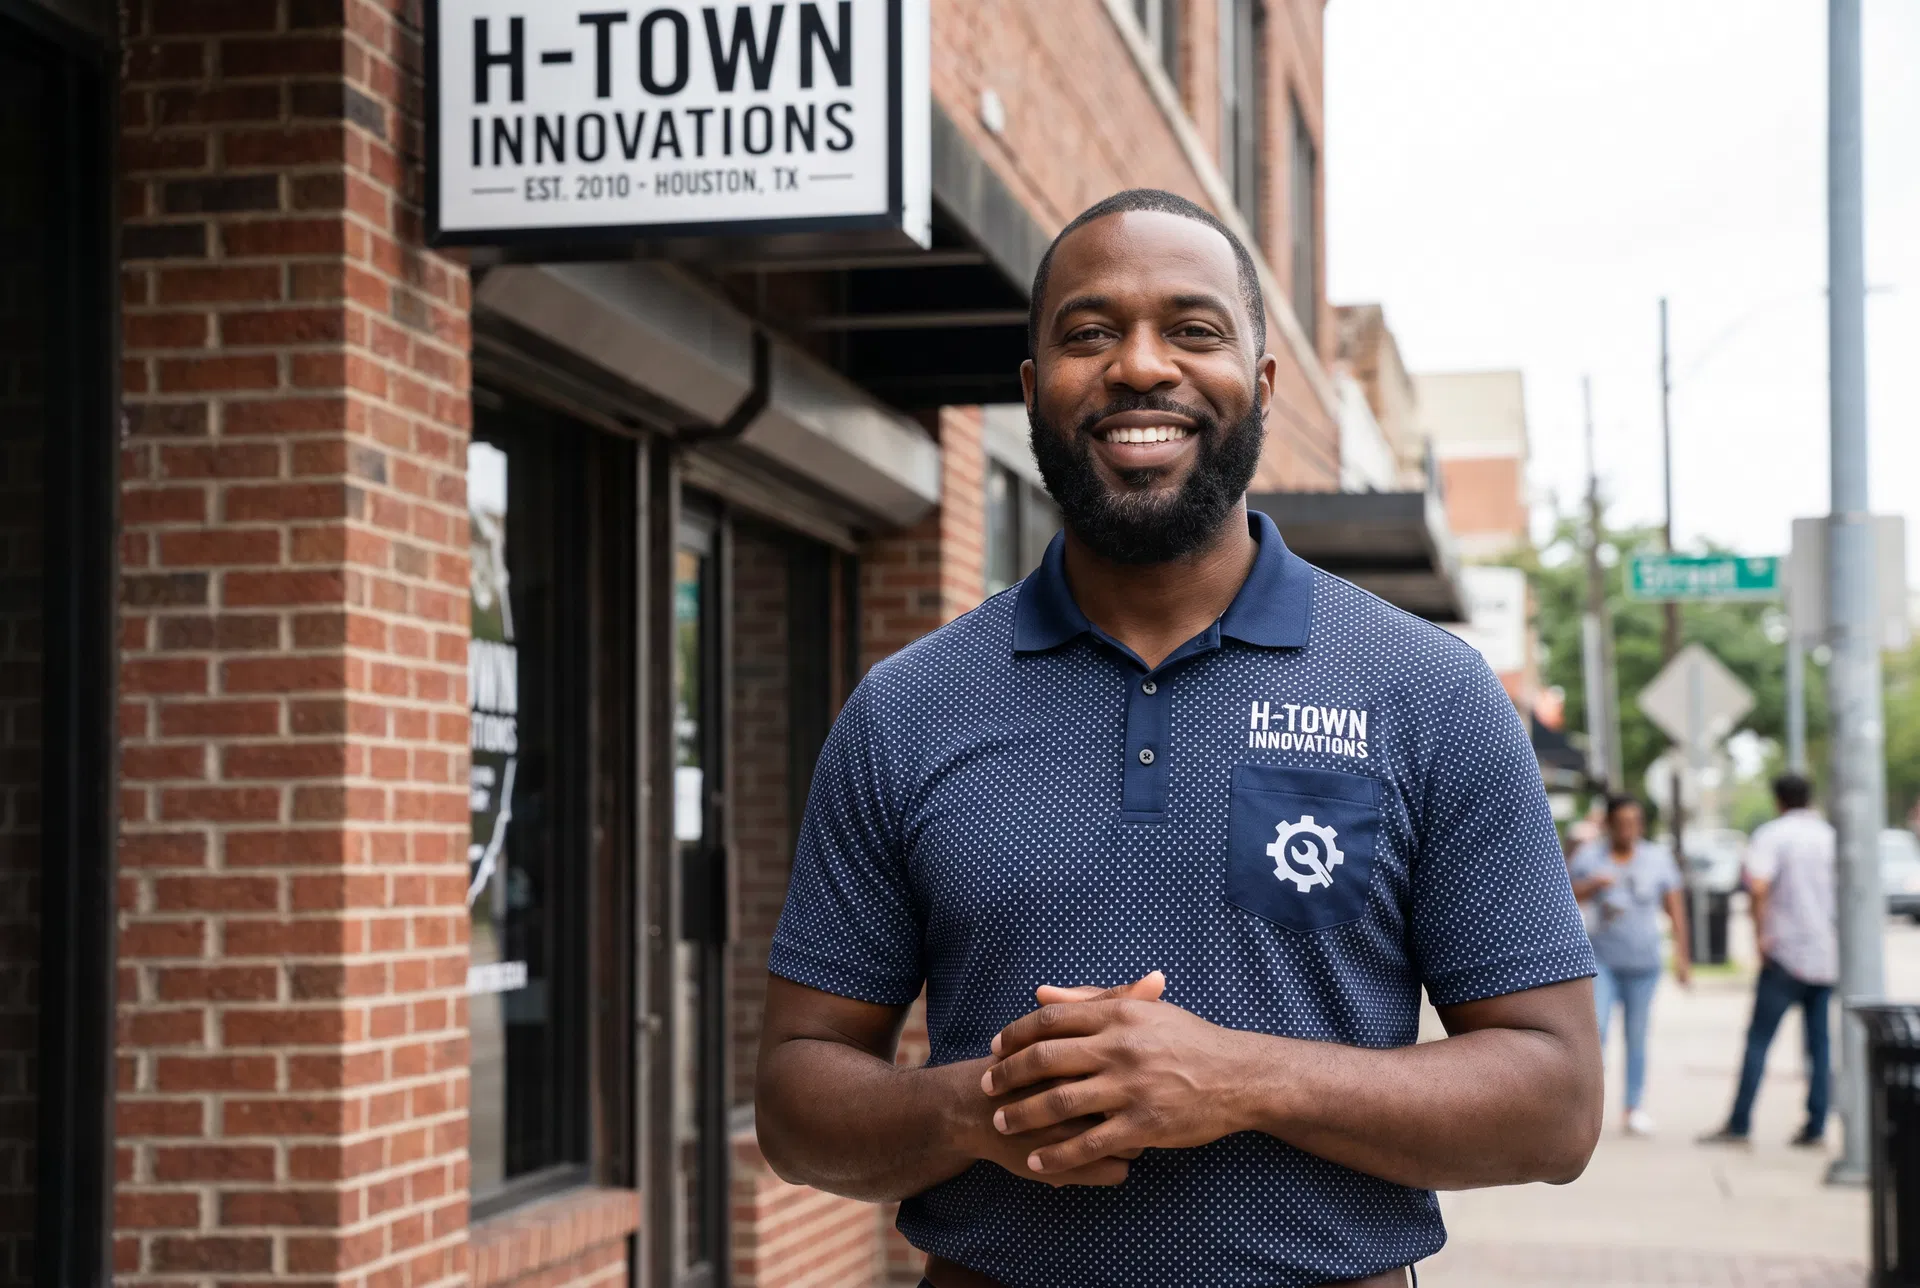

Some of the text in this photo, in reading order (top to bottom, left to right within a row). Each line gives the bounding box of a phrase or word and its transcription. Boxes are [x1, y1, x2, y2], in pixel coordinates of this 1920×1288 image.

[472, 1, 853, 104] H-TOWN
[471, 102, 854, 168] INNOVATIONS
[524, 176, 569, 201] EST.
[575, 174, 630, 200] 2010
[654, 168, 765, 197] HOUSTON,
[772, 167, 799, 191] TX
[1250, 701, 1368, 740] H-TOWN
[1249, 731, 1369, 759] INNOVATIONS
